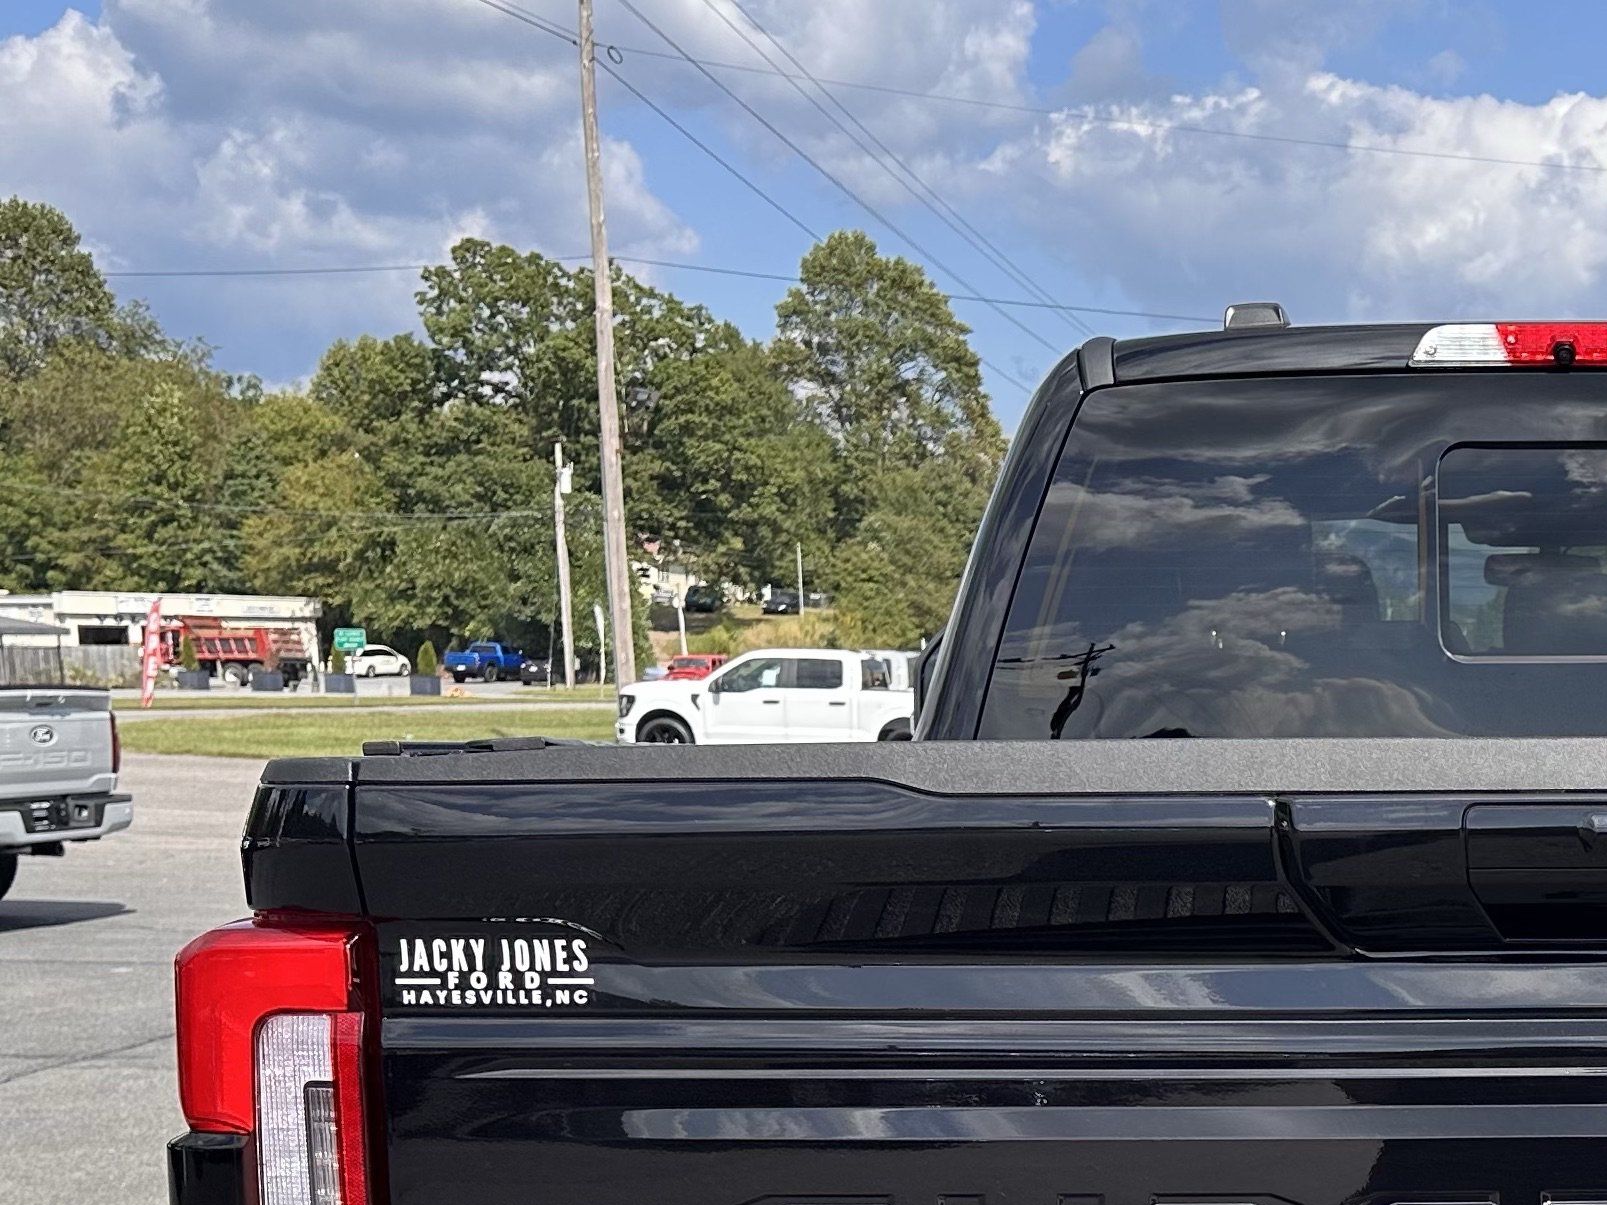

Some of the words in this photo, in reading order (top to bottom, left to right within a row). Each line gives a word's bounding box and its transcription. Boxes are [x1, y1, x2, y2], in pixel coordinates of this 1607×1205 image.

[399, 938, 485, 972] JACKY
[500, 938, 589, 972] JONES
[447, 971, 541, 990] FORD
